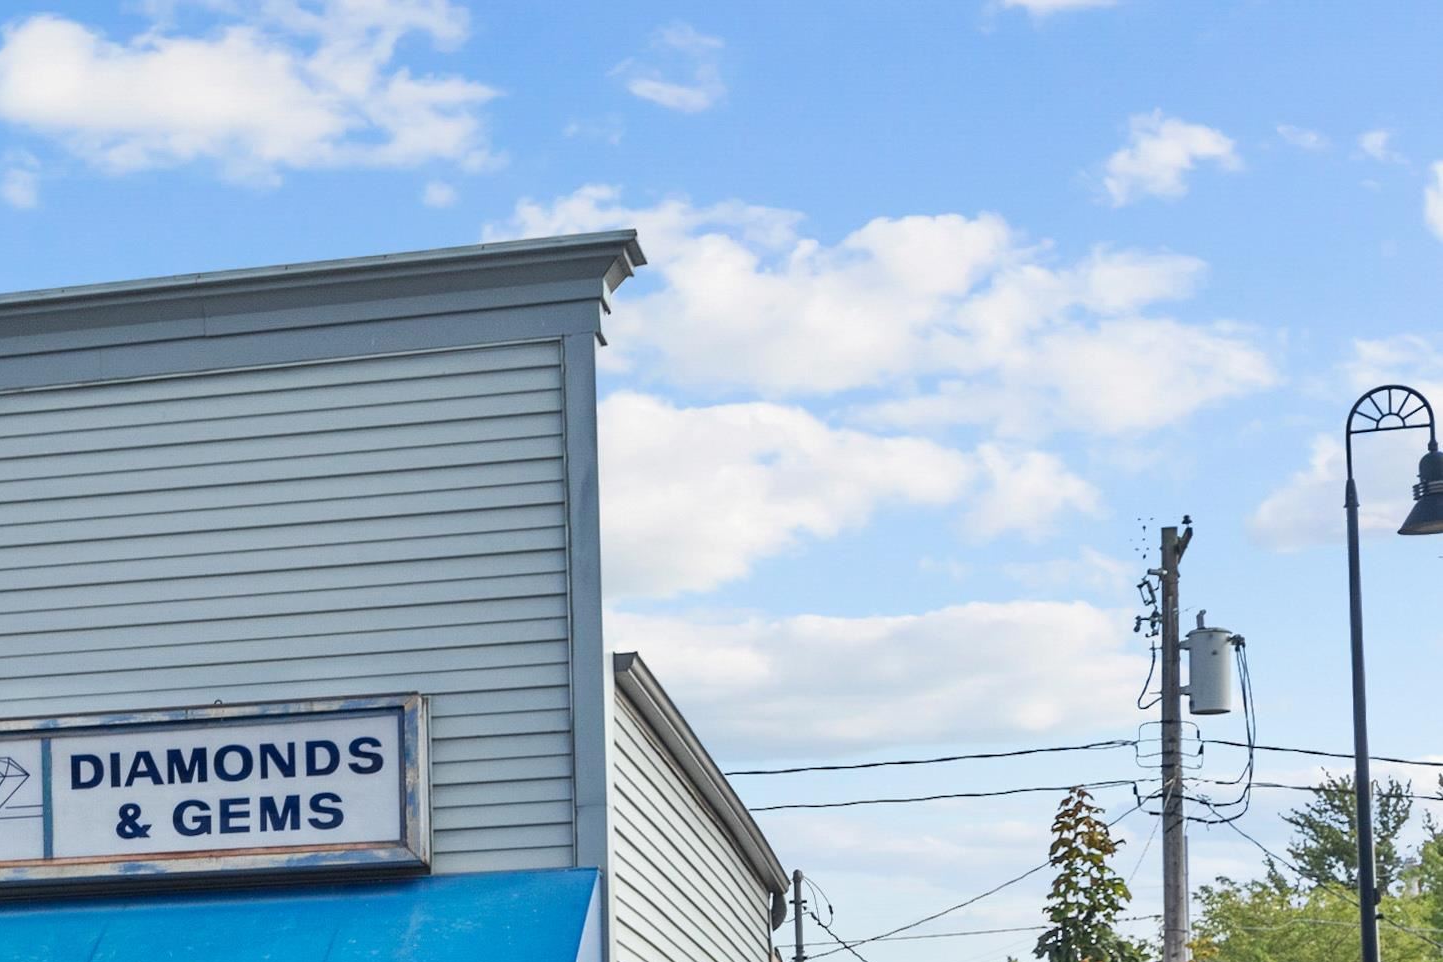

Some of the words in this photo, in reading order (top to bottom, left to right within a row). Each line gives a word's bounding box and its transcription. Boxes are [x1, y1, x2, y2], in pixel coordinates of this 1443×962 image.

[70, 736, 384, 790] DIAMONDS
[115, 803, 152, 840] &
[172, 792, 344, 838] GEMS
